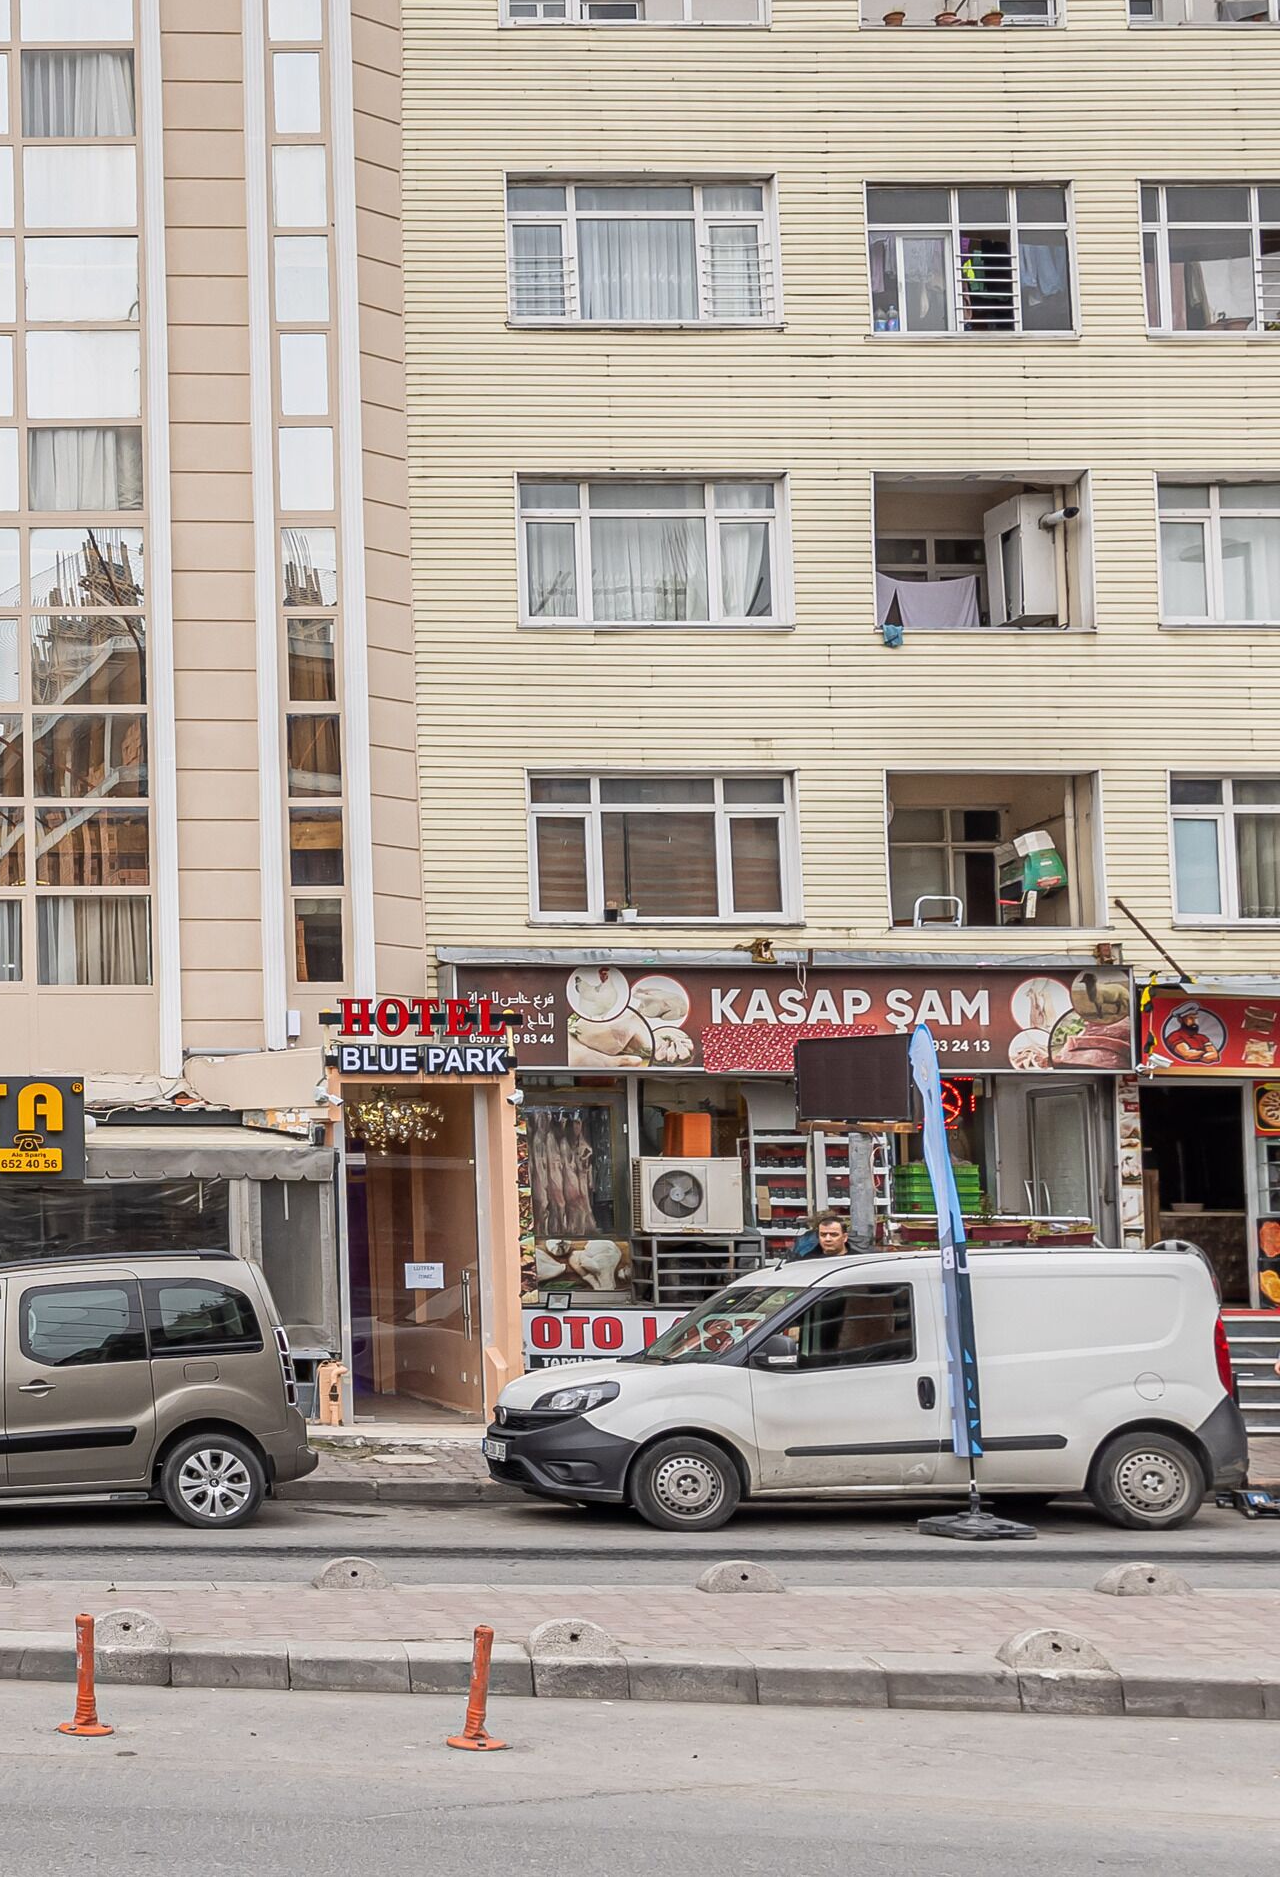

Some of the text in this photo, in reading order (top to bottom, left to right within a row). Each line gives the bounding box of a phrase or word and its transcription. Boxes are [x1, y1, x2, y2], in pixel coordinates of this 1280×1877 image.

[338, 999, 506, 1036] HOTEL
[711, 988, 990, 1034] KASAP ŞAM
[523, 1033, 537, 1044] 83
[539, 1033, 555, 1044] 44
[932, 1040, 990, 1052] 93 24 13
[342, 1047, 506, 1071] BLUE PARK
[1, 1159, 58, 1168] 652 40 56
[531, 1316, 624, 1350] OTO
